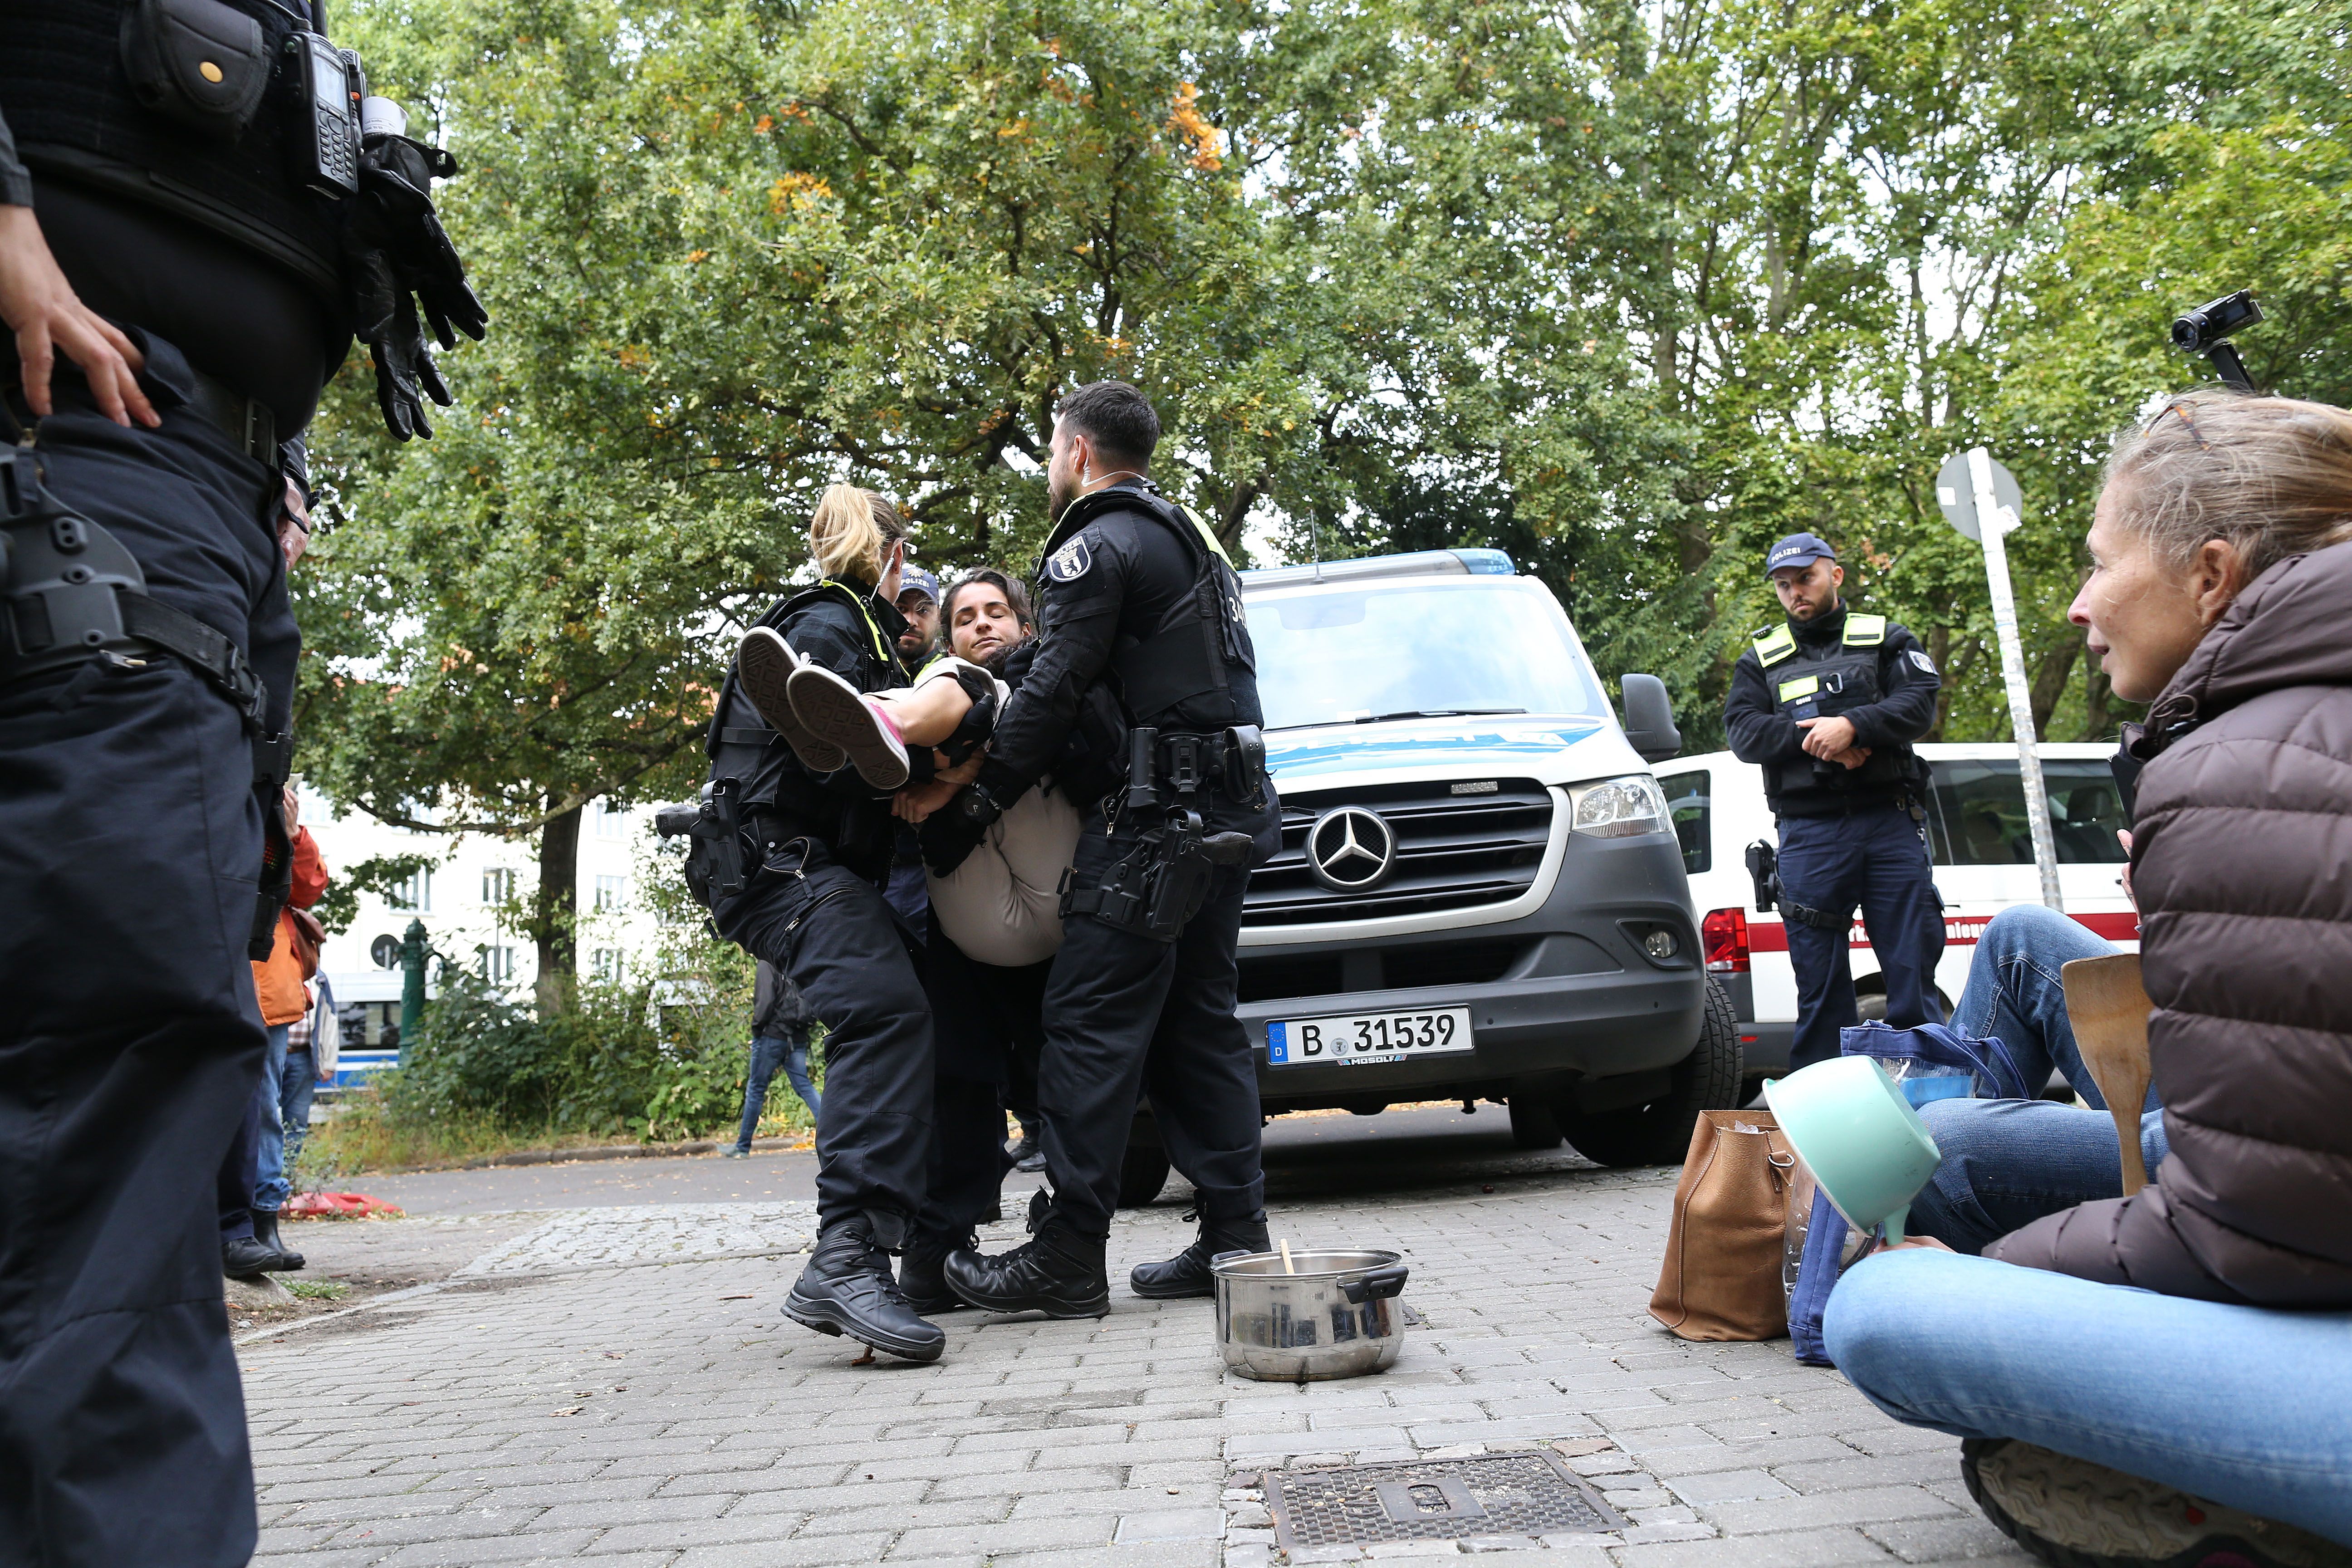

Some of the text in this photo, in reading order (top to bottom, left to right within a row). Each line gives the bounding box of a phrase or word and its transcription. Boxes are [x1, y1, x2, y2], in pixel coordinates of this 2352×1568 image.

[1050, 538, 1082, 562] POLIZEI
[1771, 547, 1801, 564] POLIZEI
[901, 578, 930, 588] POLIZEI
[1275, 1014, 1455, 1056] D B 31539
[1351, 1056, 1395, 1065] MOSOLF
